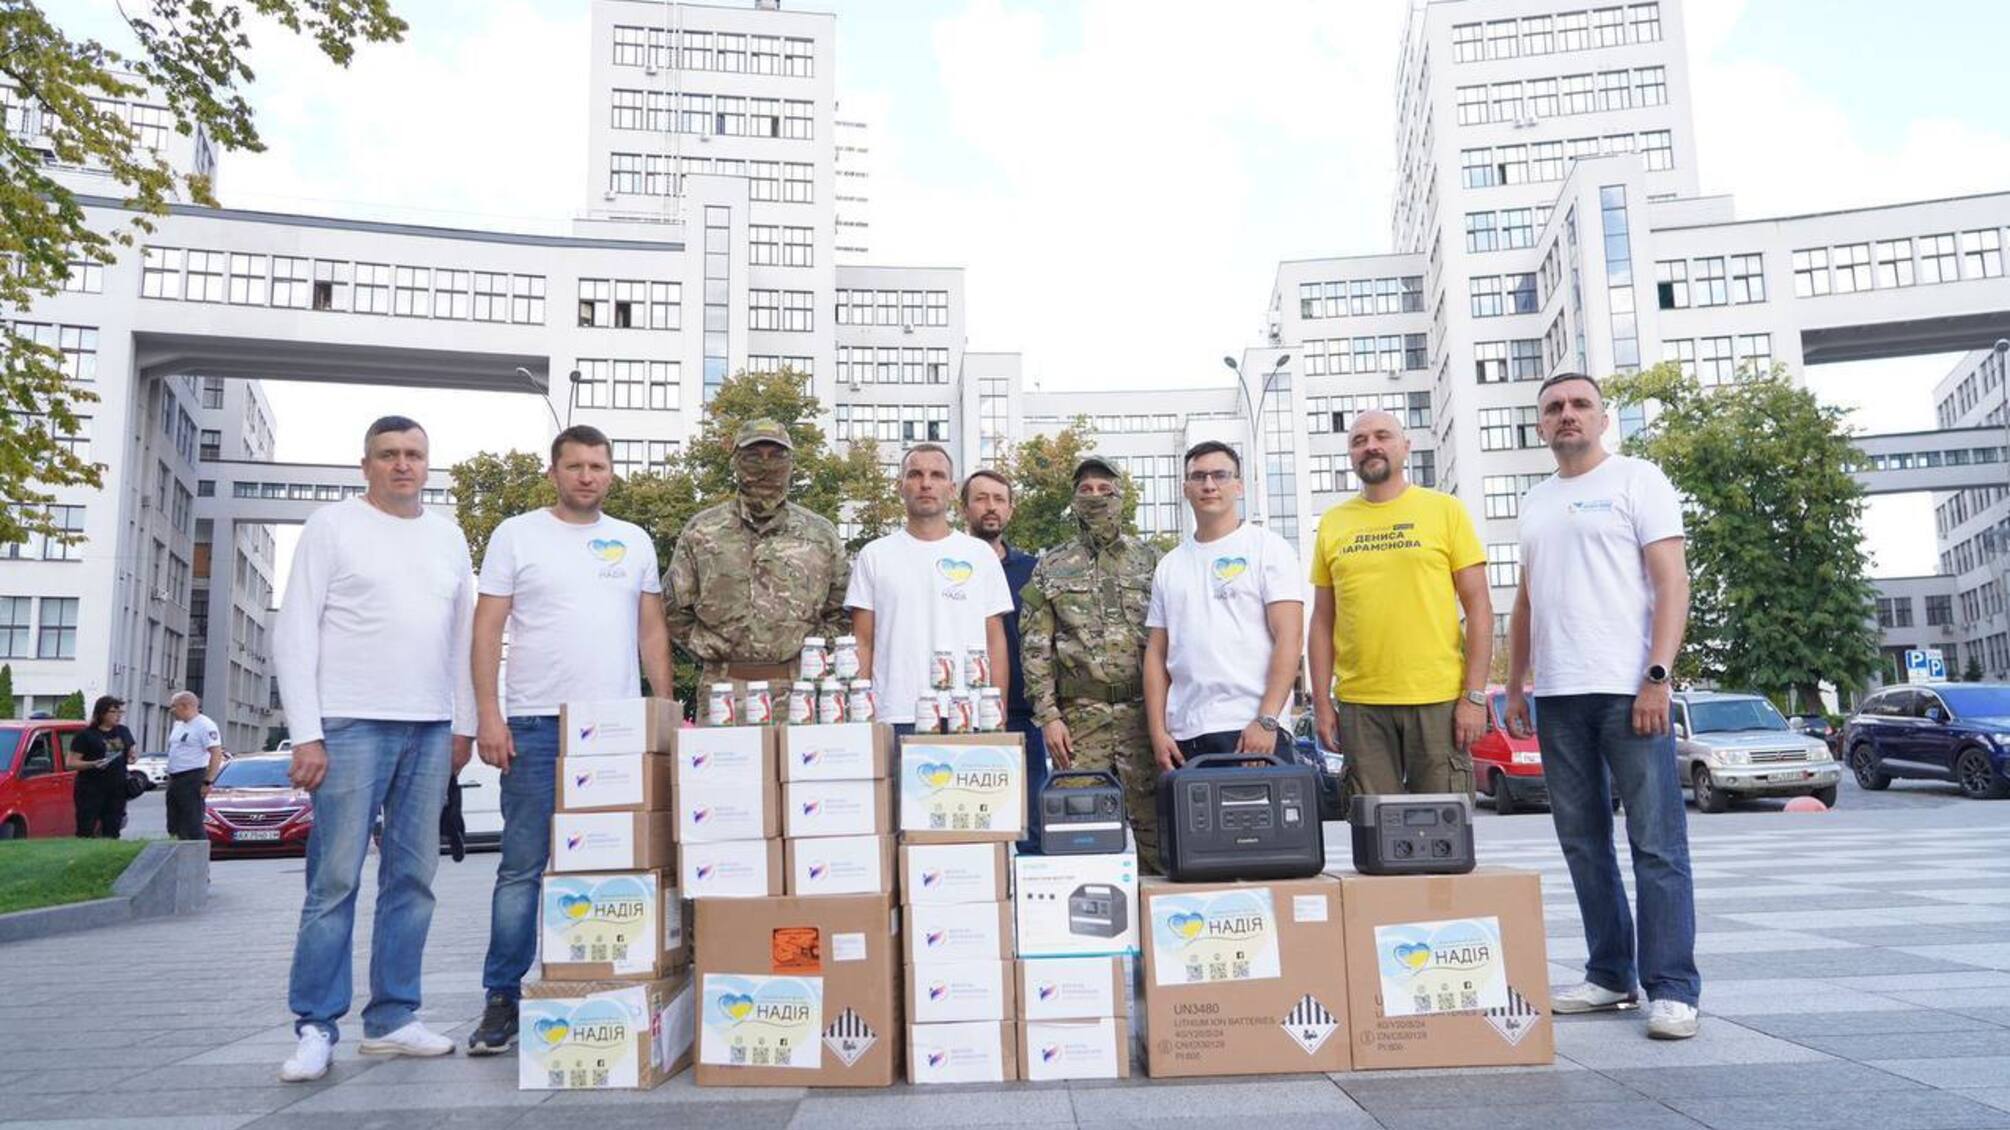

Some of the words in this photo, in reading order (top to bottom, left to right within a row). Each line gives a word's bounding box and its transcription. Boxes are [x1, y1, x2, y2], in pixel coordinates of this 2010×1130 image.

[1354, 531, 1404, 543] ДЕНИСА
[1911, 652, 1924, 668] P
[1931, 660, 1941, 676] P
[956, 772, 1009, 789] НАДІЯ
[594, 902, 645, 918] НАДІЯ
[1208, 916, 1264, 936] НАДІЯ
[1434, 946, 1490, 966] НАДІЯ
[756, 1004, 810, 1021] НАДІЯ
[1173, 1003, 1220, 1015] UN3480
[1174, 1018, 1208, 1027] LITHIUM
[1209, 1018, 1226, 1027] ION
[1227, 1016, 1276, 1026] BATTERIES
[573, 1026, 625, 1043] НАДІЯ
